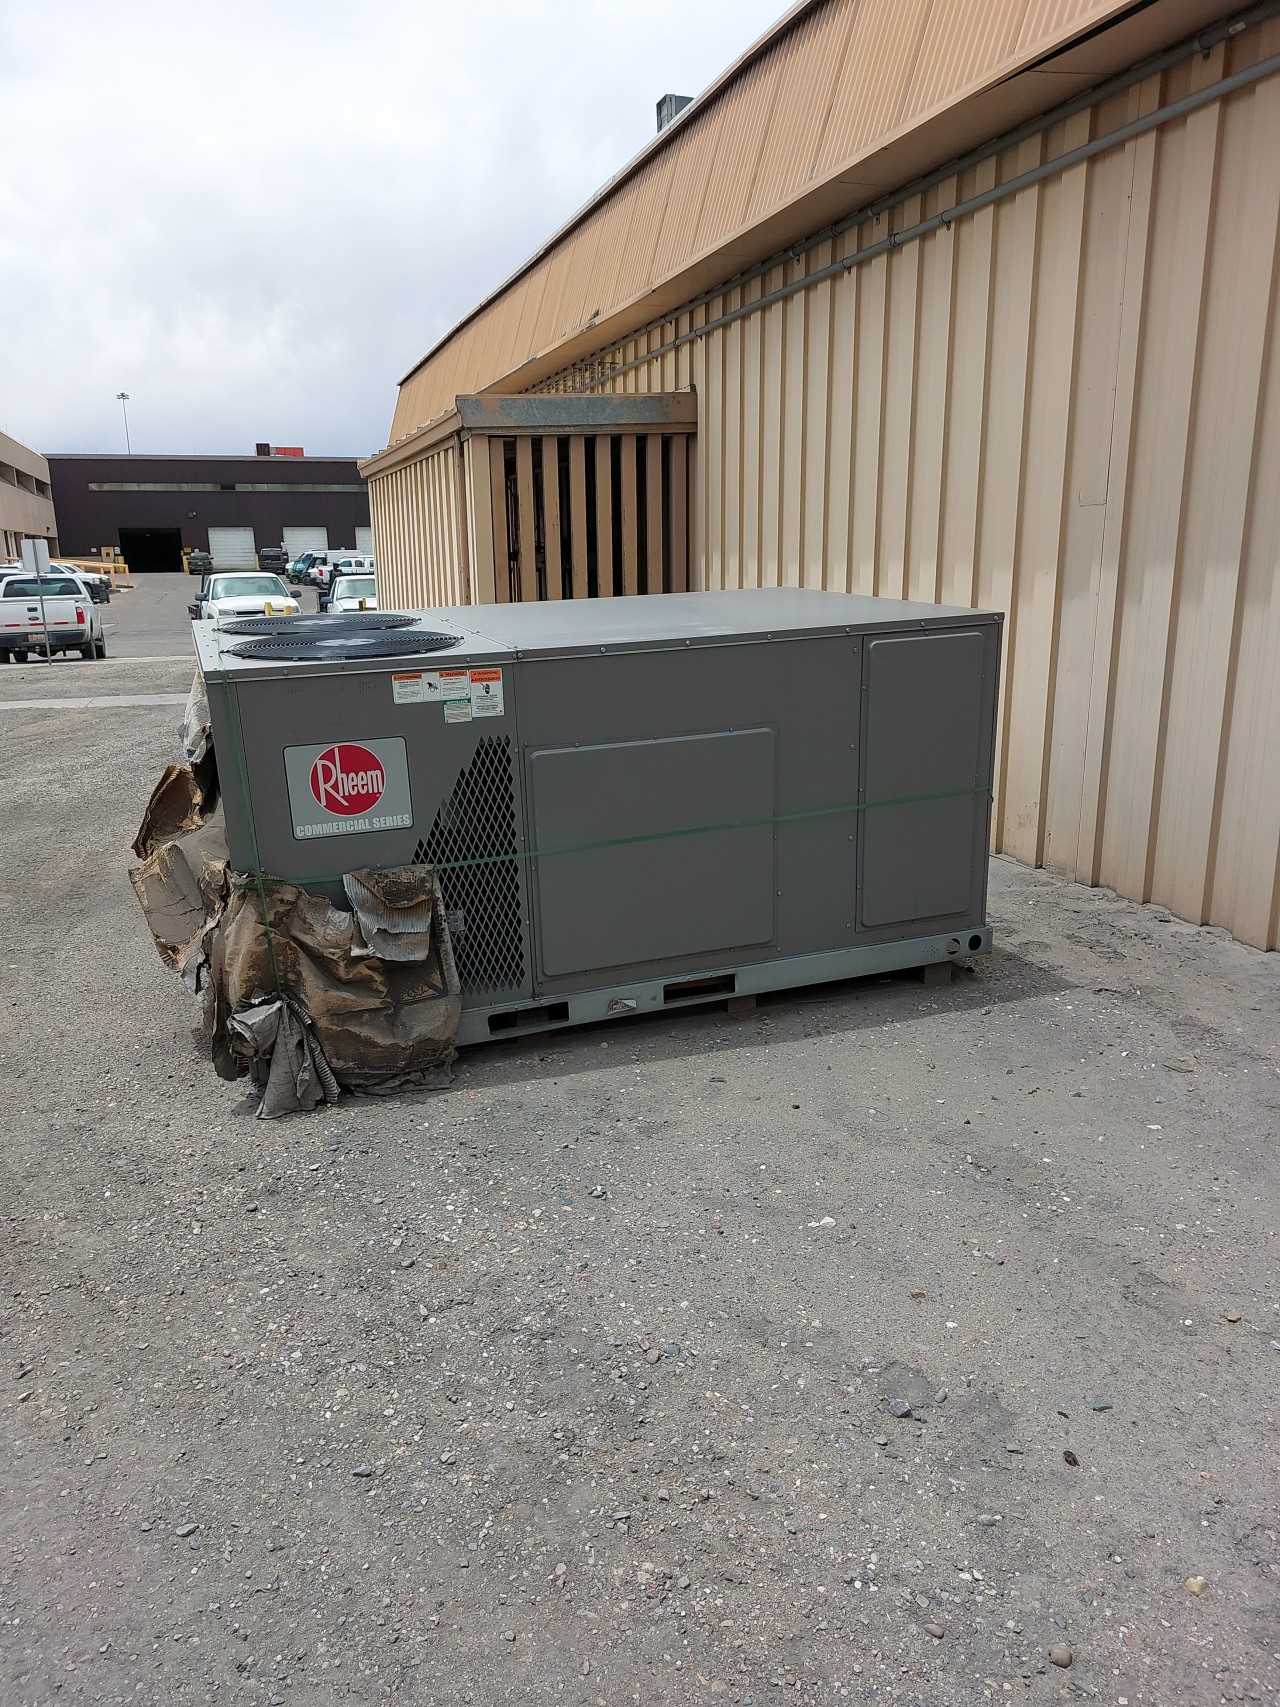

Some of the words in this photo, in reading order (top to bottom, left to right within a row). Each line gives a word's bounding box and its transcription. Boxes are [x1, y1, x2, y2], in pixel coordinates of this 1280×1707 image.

[316, 747, 383, 806] Rheem
[296, 818, 371, 837] COMMERCIAL
[372, 814, 411, 829] SERIES
